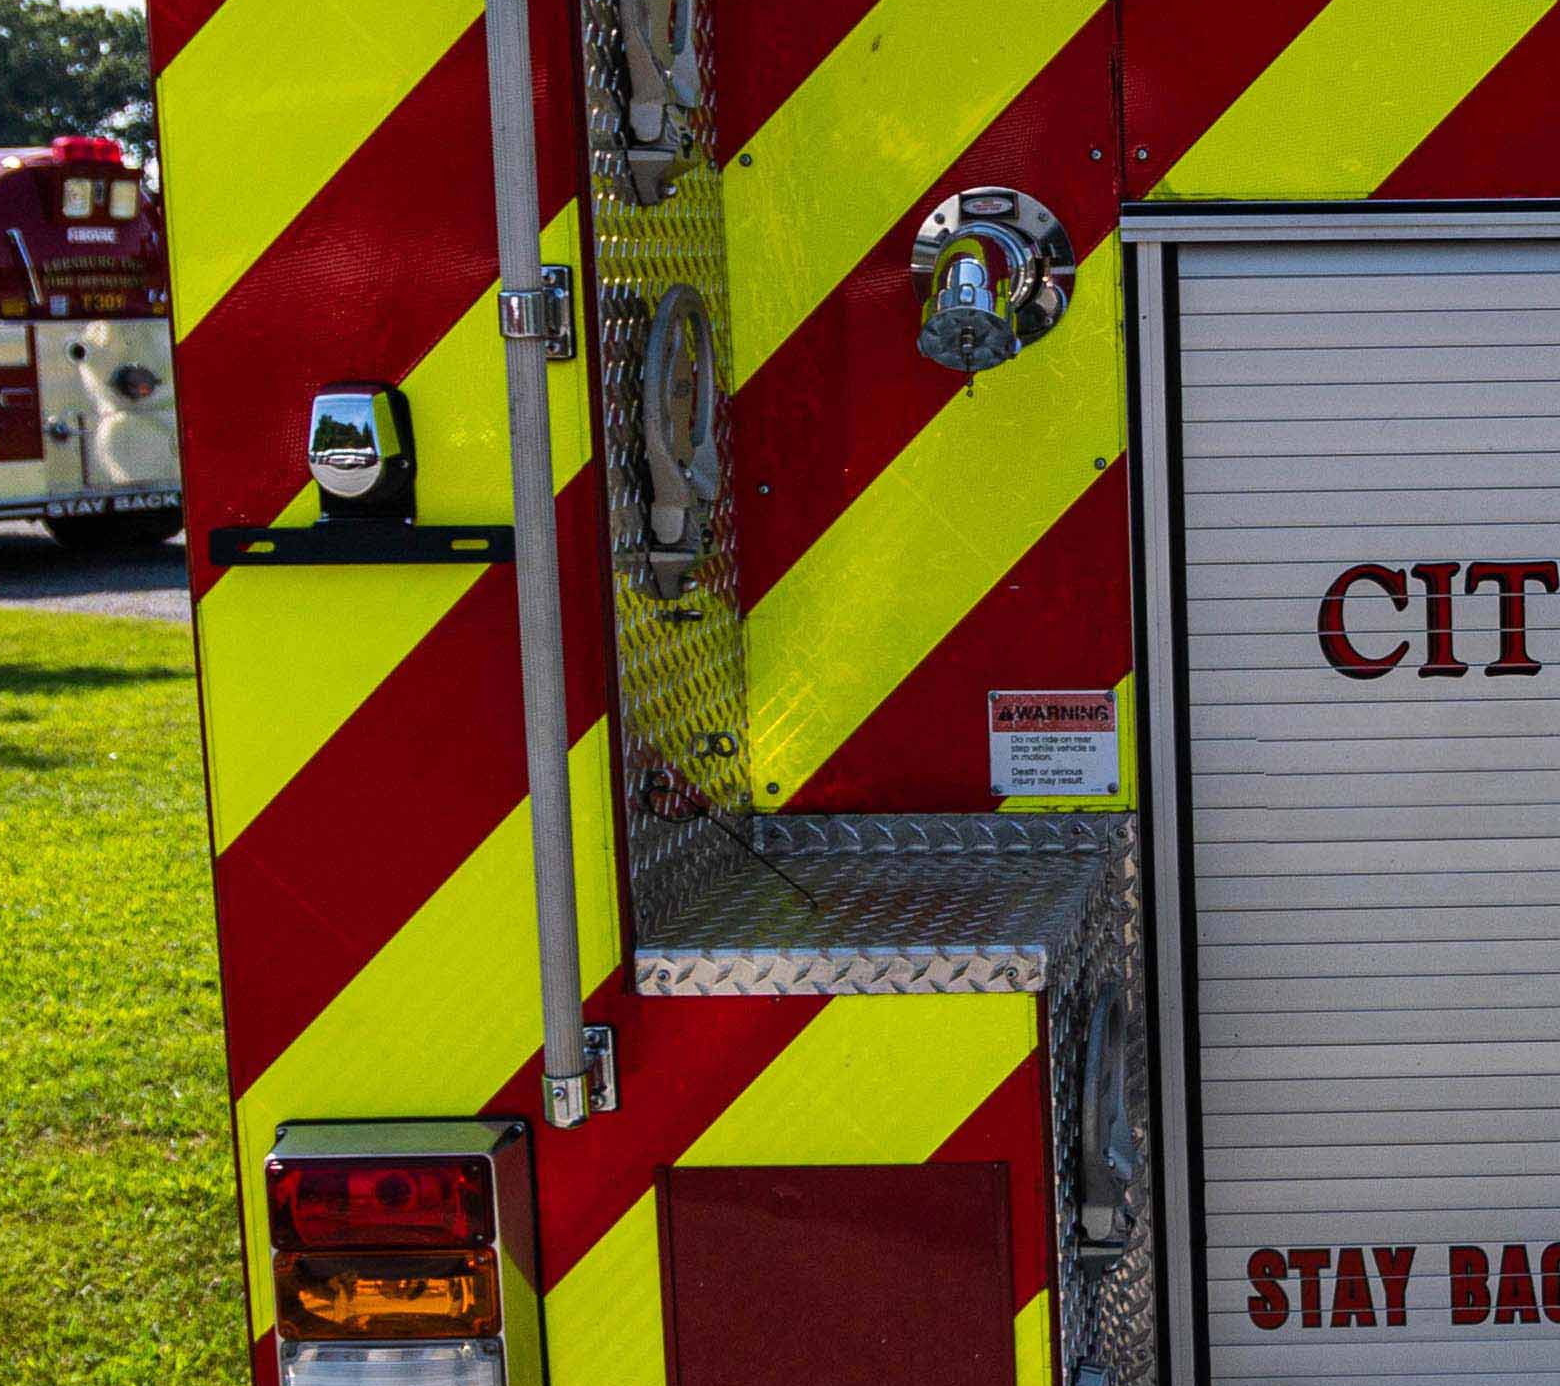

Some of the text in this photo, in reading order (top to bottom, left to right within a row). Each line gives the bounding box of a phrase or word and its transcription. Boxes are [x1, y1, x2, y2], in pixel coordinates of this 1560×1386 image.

[47, 493, 180, 517] STAY BACK
[1015, 704, 1109, 721] WARNING
[1011, 735, 1024, 743] Do
[1025, 735, 1040, 743] not
[1042, 735, 1058, 743] ride
[1011, 744, 1097, 753] step while vehicle is
[1011, 753, 1019, 761] in
[1011, 767, 1038, 775] Death
[1051, 767, 1083, 775] serious
[1011, 777, 1036, 786] injury
[1037, 778, 1057, 786] may
[1246, 1246, 1417, 1330] STAY
